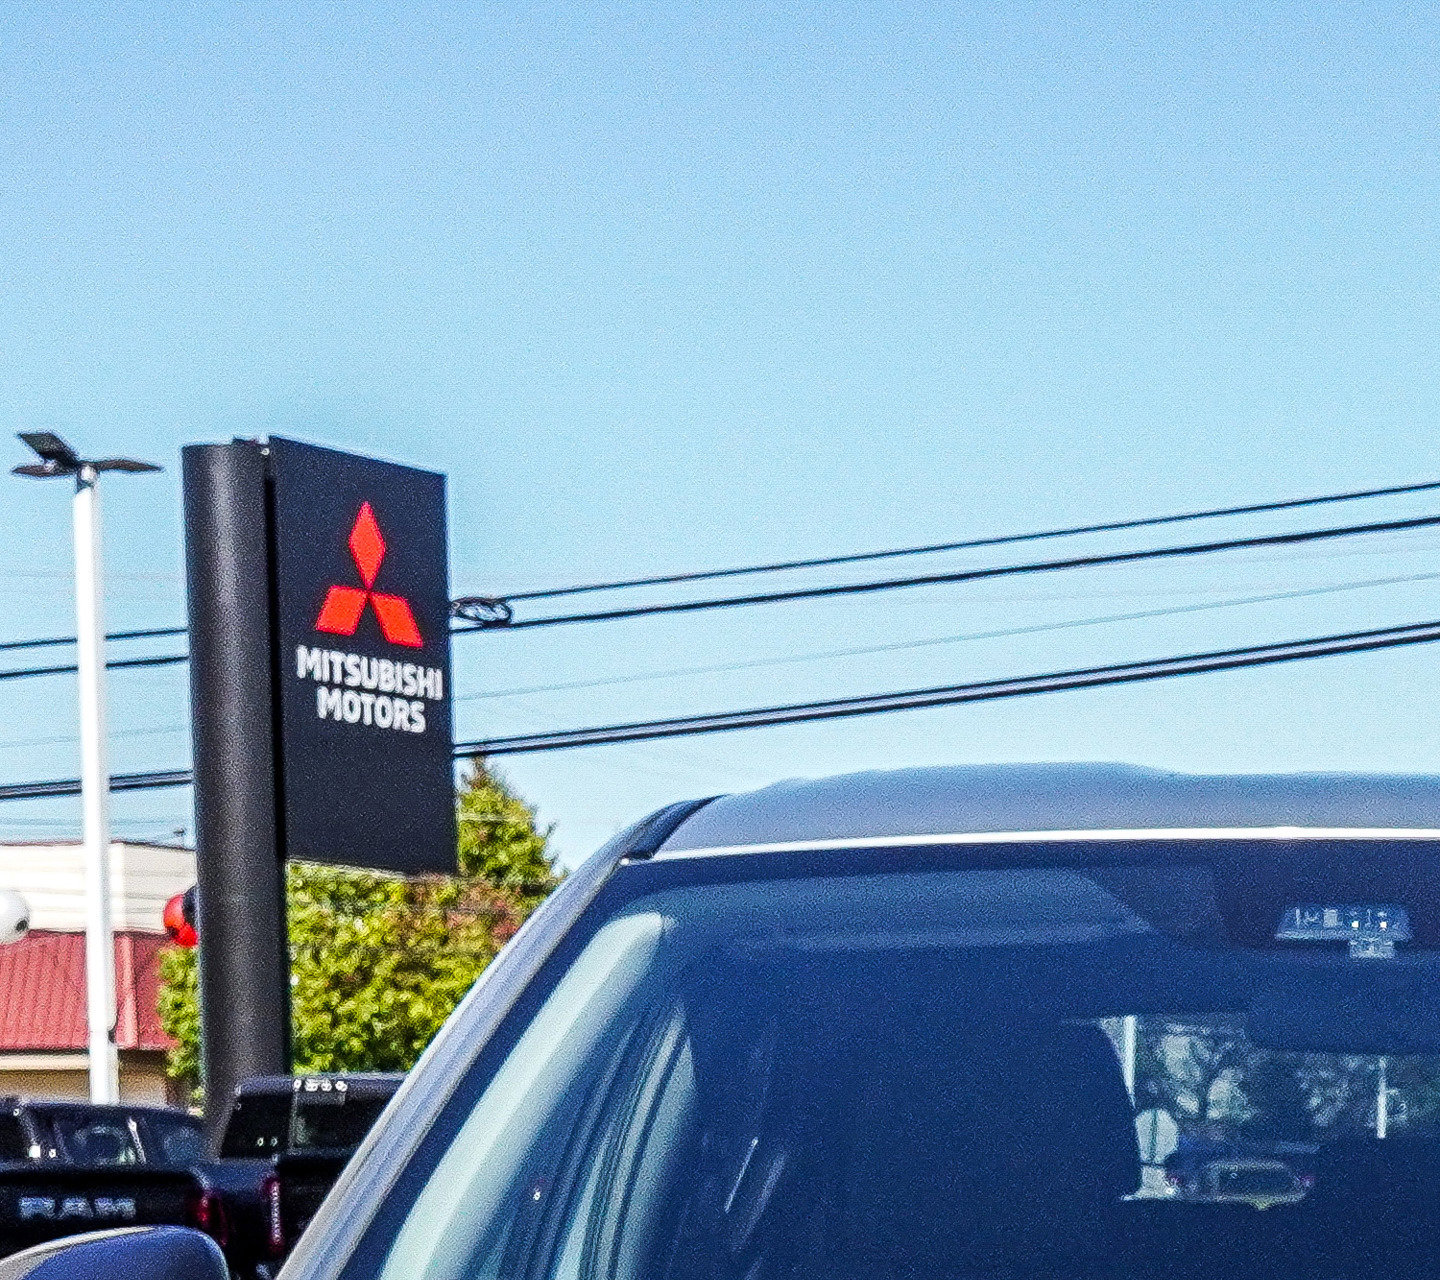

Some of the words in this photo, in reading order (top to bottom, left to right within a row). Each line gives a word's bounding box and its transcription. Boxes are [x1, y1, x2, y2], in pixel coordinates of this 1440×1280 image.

[297, 645, 444, 700] MITSUBISHI
[317, 686, 427, 733] MOTORS
[19, 1196, 137, 1221] RAM
